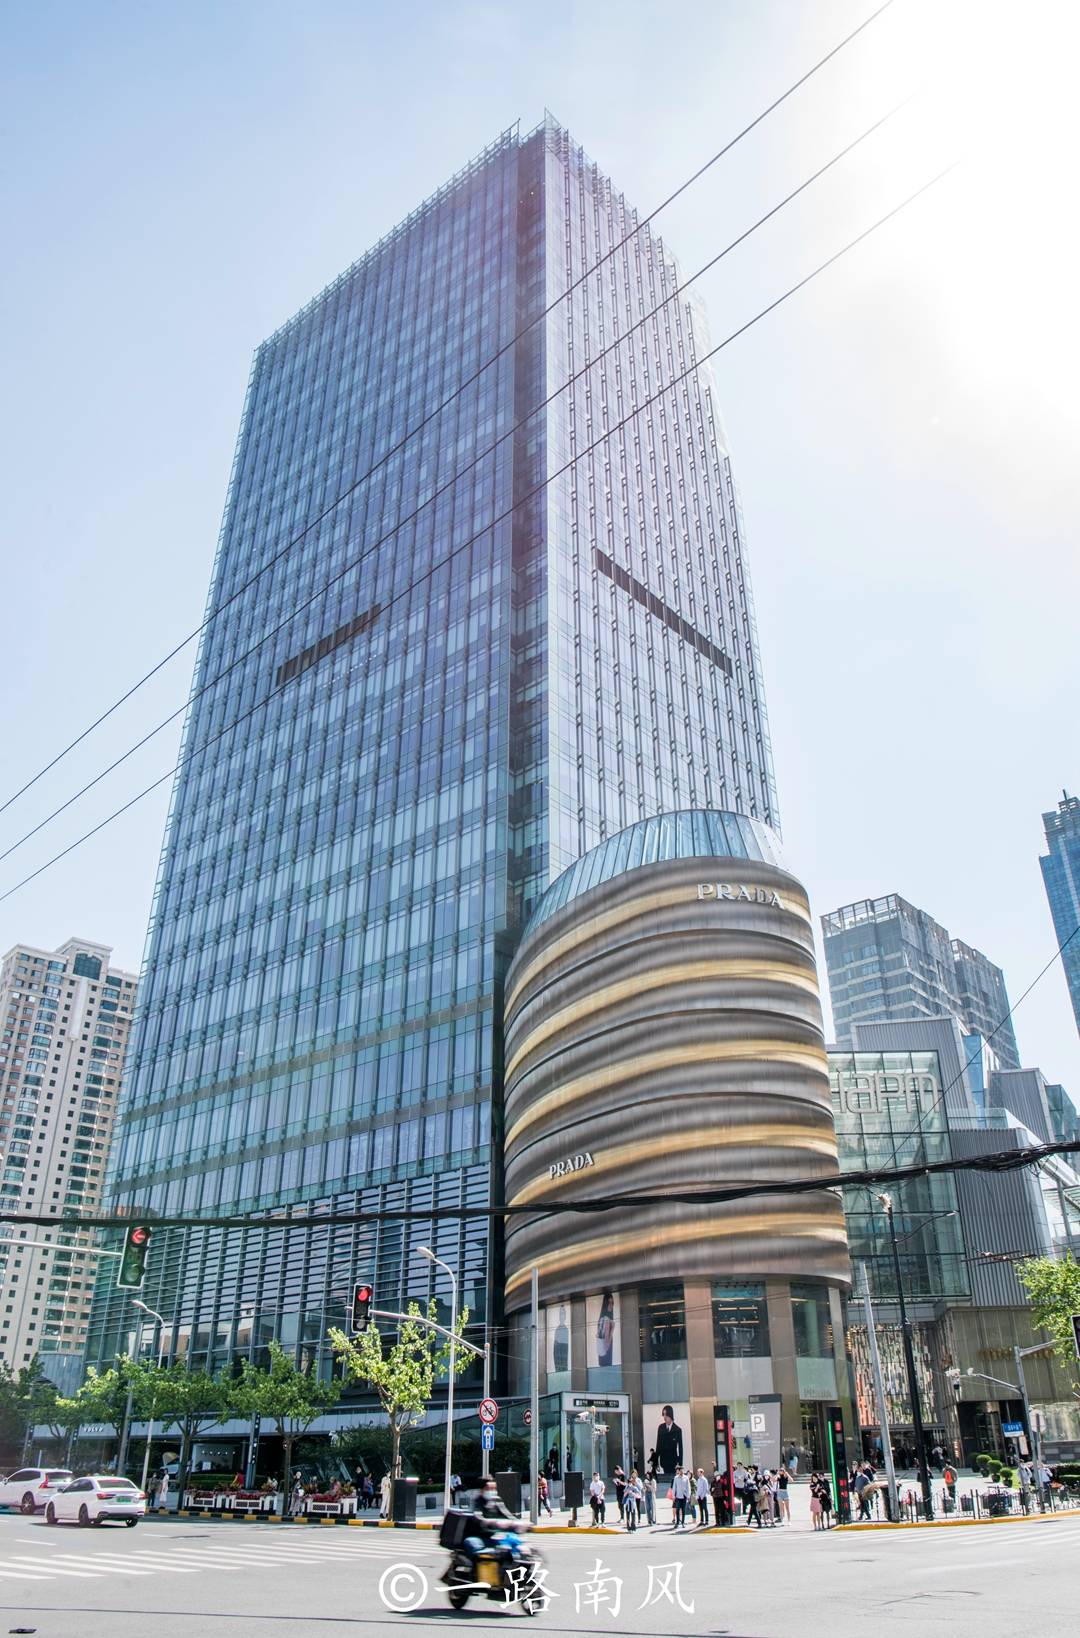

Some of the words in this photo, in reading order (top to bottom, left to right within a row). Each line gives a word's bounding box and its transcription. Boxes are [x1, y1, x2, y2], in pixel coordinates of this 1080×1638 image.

[697, 883, 785, 909] PRADA
[549, 1152, 594, 1180] PRADA
[753, 1416, 762, 1430] P
